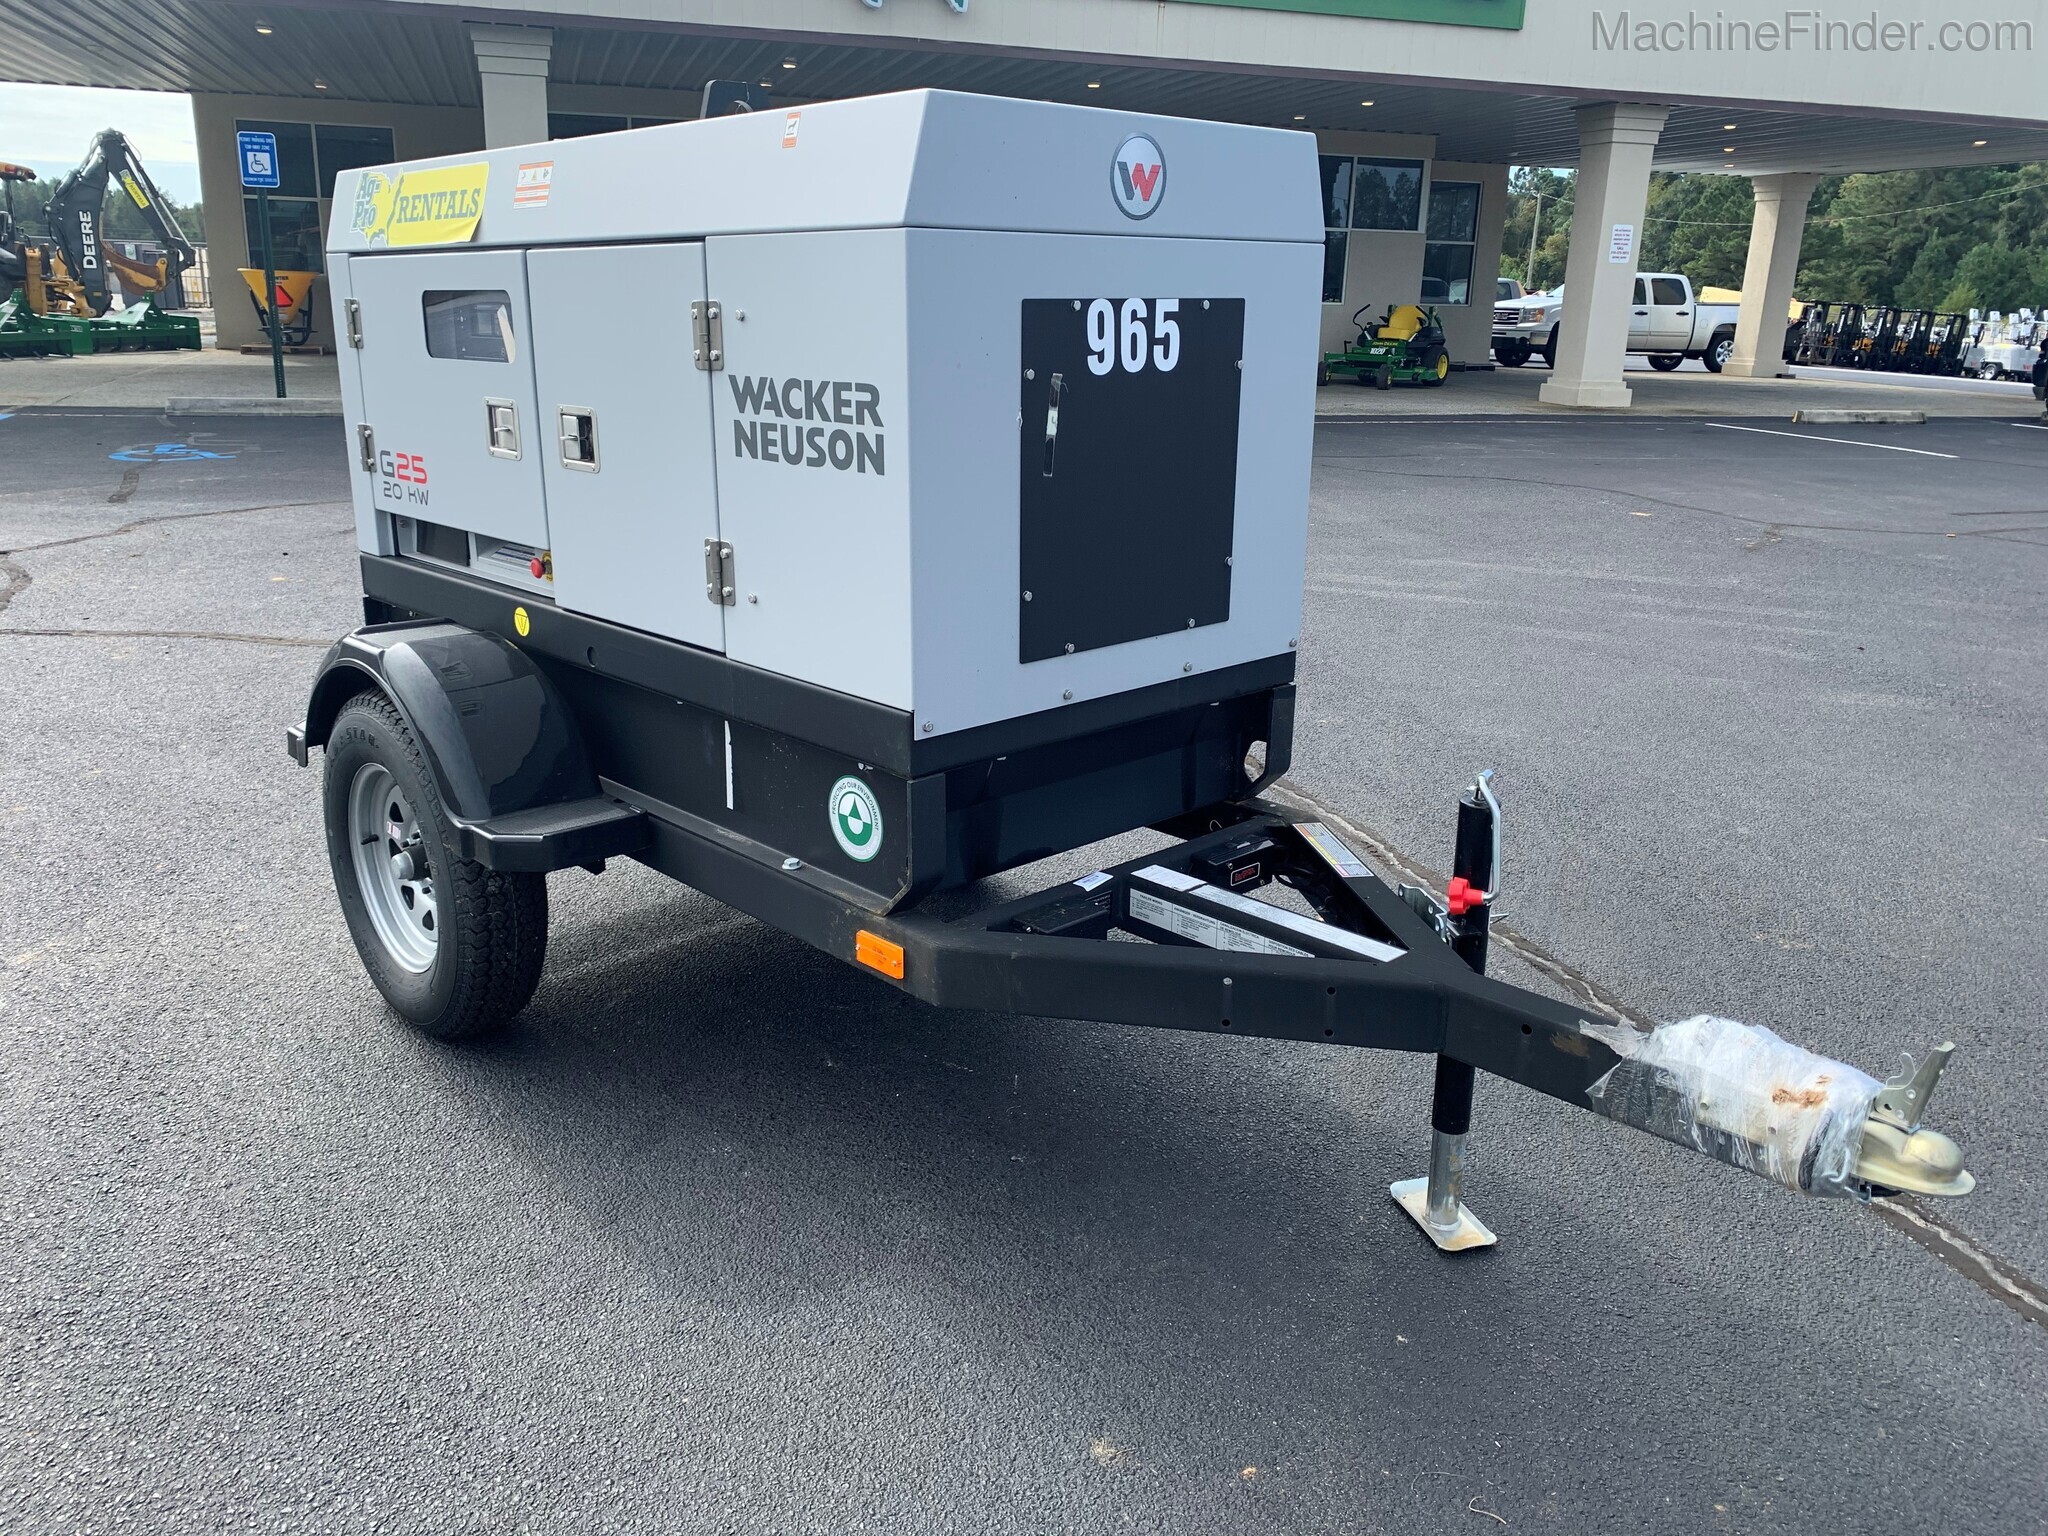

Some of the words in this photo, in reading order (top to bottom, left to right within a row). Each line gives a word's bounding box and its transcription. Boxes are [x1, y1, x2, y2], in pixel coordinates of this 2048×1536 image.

[352, 202, 377, 230] Pro
[396, 187, 481, 224] RENTALS
[79, 210, 98, 269] DEERE
[1086, 297, 1181, 376] 965
[728, 374, 885, 427] WACKER
[379, 449, 428, 484] G25
[733, 419, 886, 476] NEUSON
[383, 480, 403, 501] 20
[831, 781, 847, 815] PROTECTING
[846, 781, 857, 790] OUR
[857, 784, 879, 831] ENVIRONMENT
